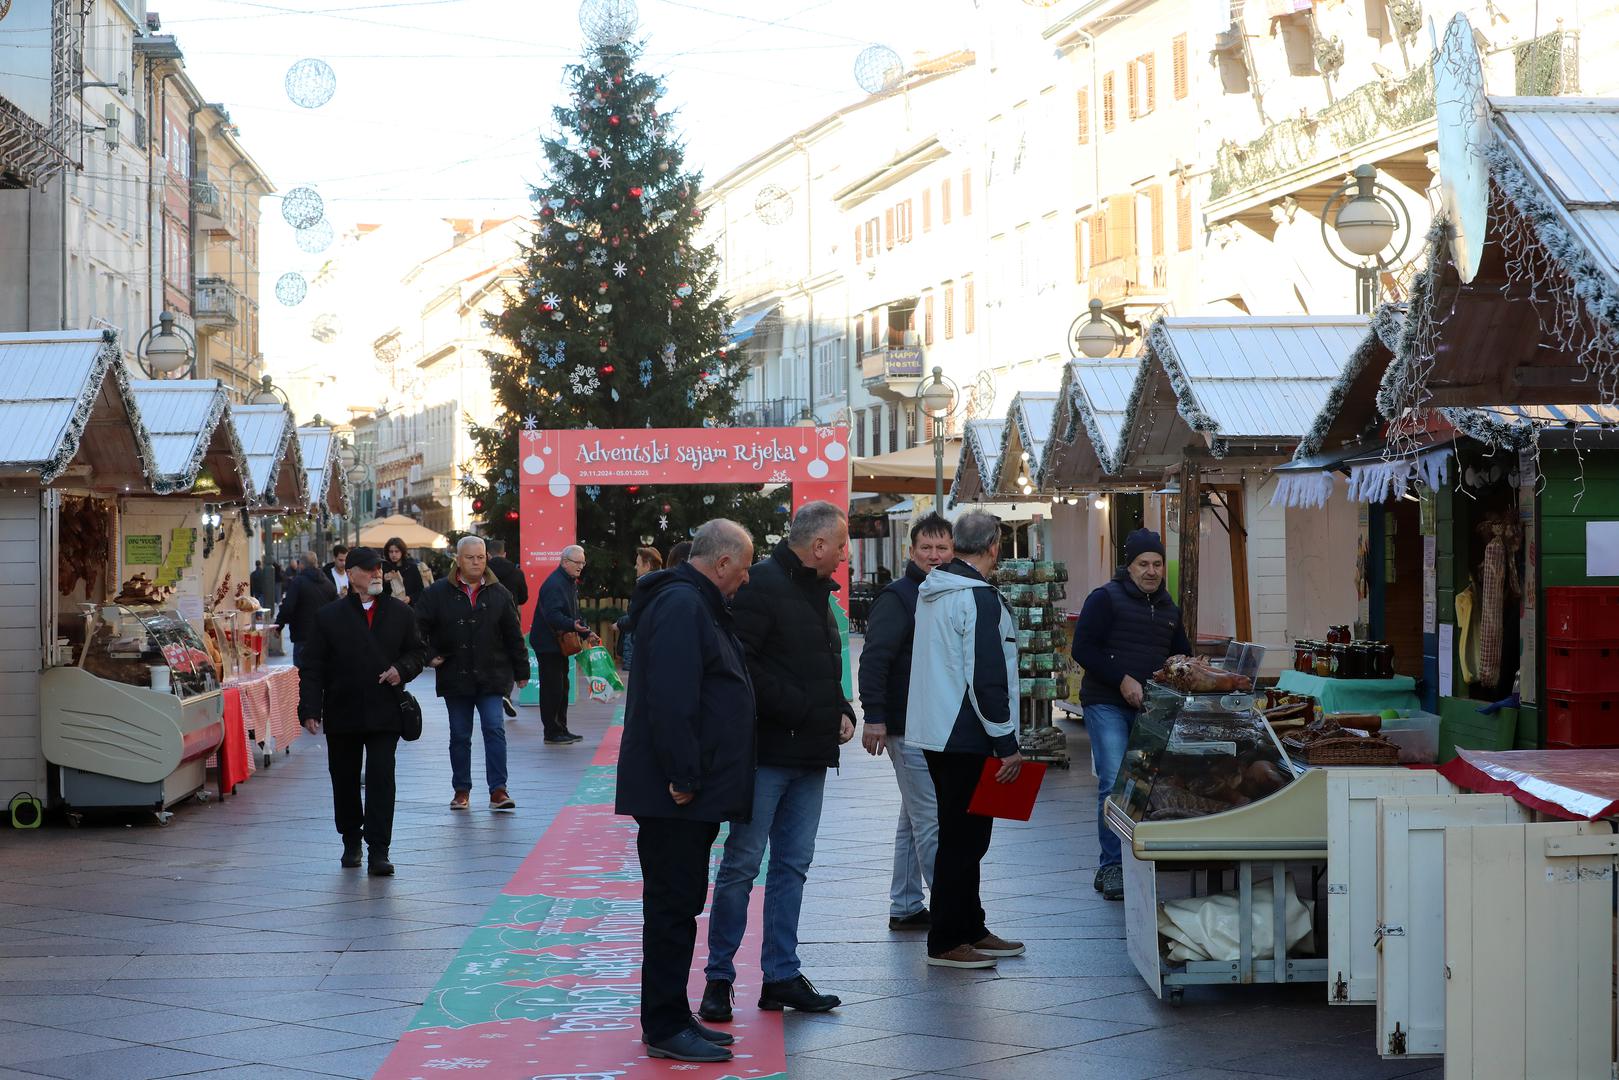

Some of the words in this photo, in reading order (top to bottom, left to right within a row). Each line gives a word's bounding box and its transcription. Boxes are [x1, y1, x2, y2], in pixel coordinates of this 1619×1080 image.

[576, 440, 670, 463] Adventski
[675, 445, 727, 471] sajam
[731, 438, 796, 471] Rijeka
[515, 983, 642, 1034] Rijeka
